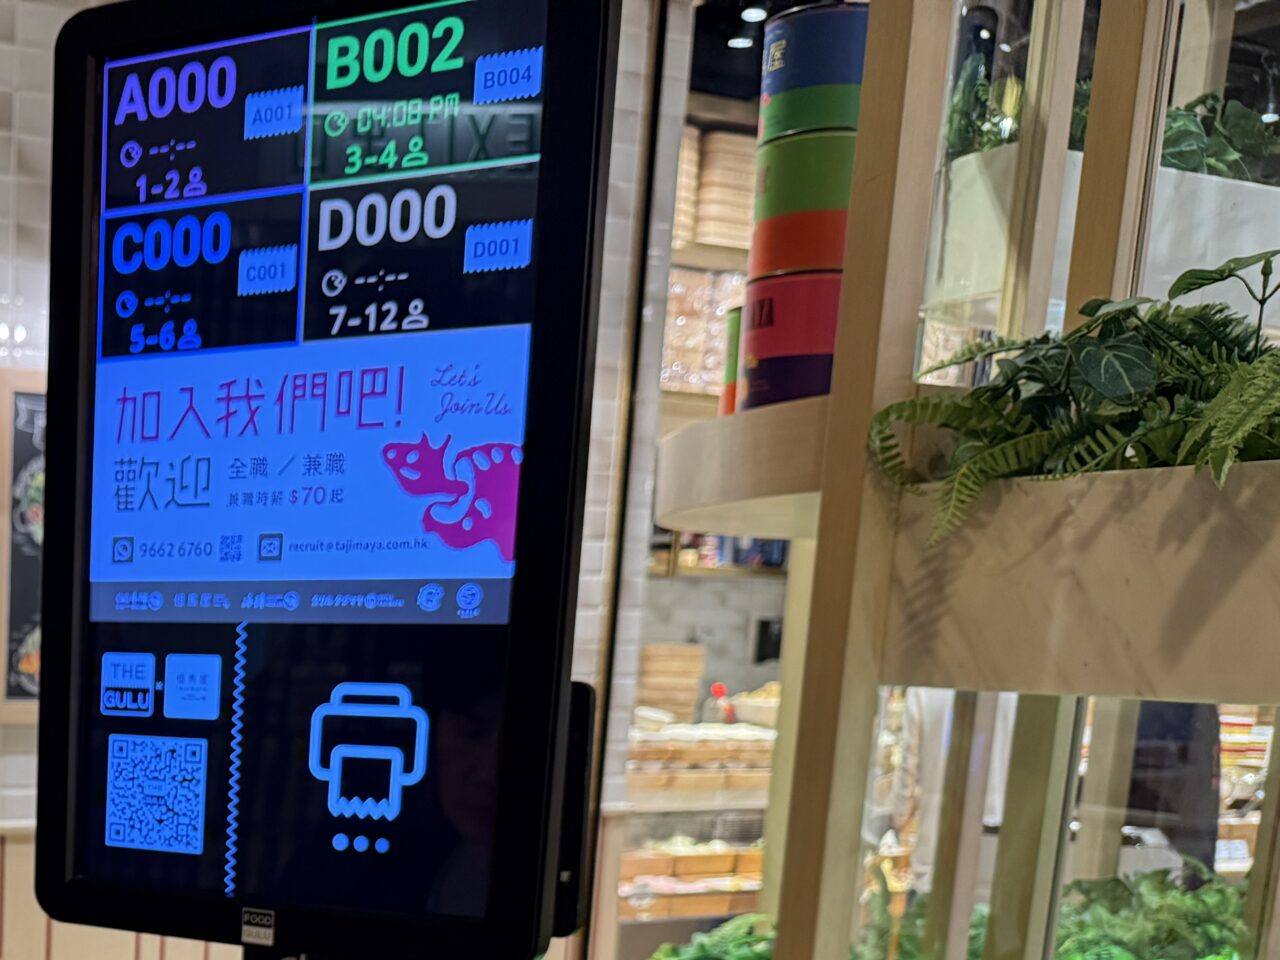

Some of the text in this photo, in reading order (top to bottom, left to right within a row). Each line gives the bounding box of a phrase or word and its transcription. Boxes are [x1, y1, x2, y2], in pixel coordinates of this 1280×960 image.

[327, 17, 464, 89] B002
[115, 56, 237, 125] A000
[483, 68, 532, 89] B004
[252, 105, 293, 125] A001
[357, 93, 459, 132] 04:08 PM
[344, 140, 397, 174] 3-4
[136, 174, 180, 202] 1-2
[319, 186, 456, 251] D000
[112, 212, 231, 274] C000
[474, 238, 520, 258] D001
[246, 264, 286, 282] C001
[329, 303, 397, 335] 7-12
[130, 324, 175, 352] 5-6
[431, 364, 481, 387] Let's
[114, 455, 211, 511] 歡迎
[111, 664, 145, 680] THE
[103, 690, 150, 710] GULU
[244, 913, 272, 925] FOOD
